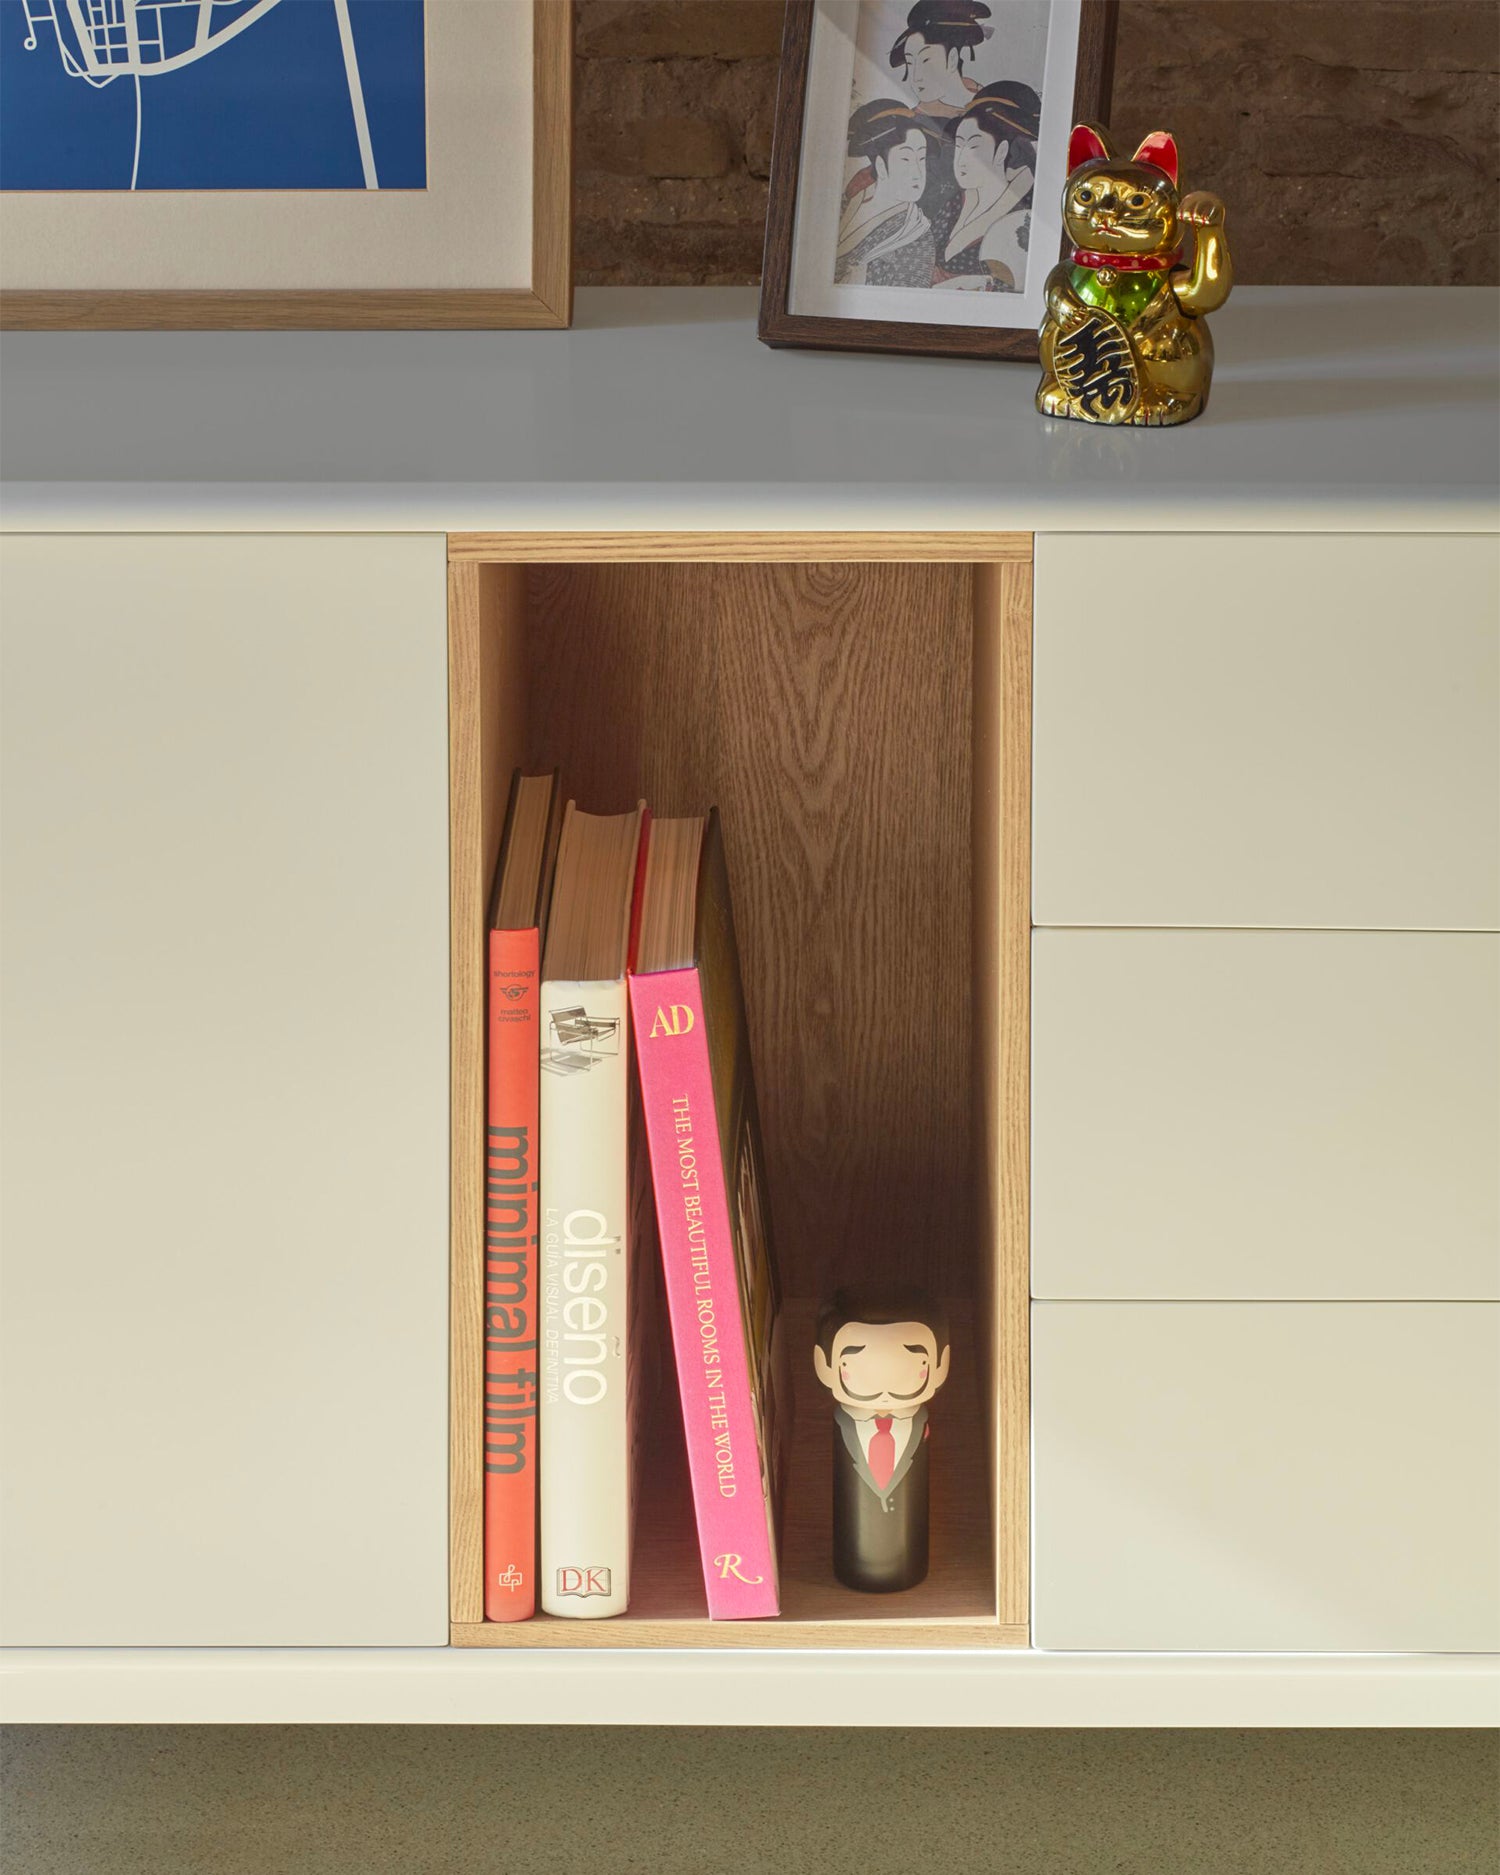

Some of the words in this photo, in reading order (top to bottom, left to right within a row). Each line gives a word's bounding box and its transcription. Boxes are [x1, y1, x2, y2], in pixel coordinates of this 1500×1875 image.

[649, 1003, 696, 1039] AD
[671, 1096, 692, 1133] THE
[677, 1138, 700, 1190] MOST
[486, 1126, 538, 1352] minimal
[545, 1208, 560, 1227] LA
[683, 1196, 711, 1295] BEAUTIFUL
[545, 1273, 560, 1324] VISUAL
[563, 1208, 622, 1406] diseño
[696, 1299, 721, 1364] ROOMS
[545, 1329, 560, 1405] DEFINITIVA
[706, 1369, 722, 1389] IN
[486, 1369, 538, 1474] film
[709, 1393, 729, 1430] THE
[714, 1433, 737, 1498] WORLD
[560, 1568, 607, 1593] DK
[713, 1552, 764, 1585] R
